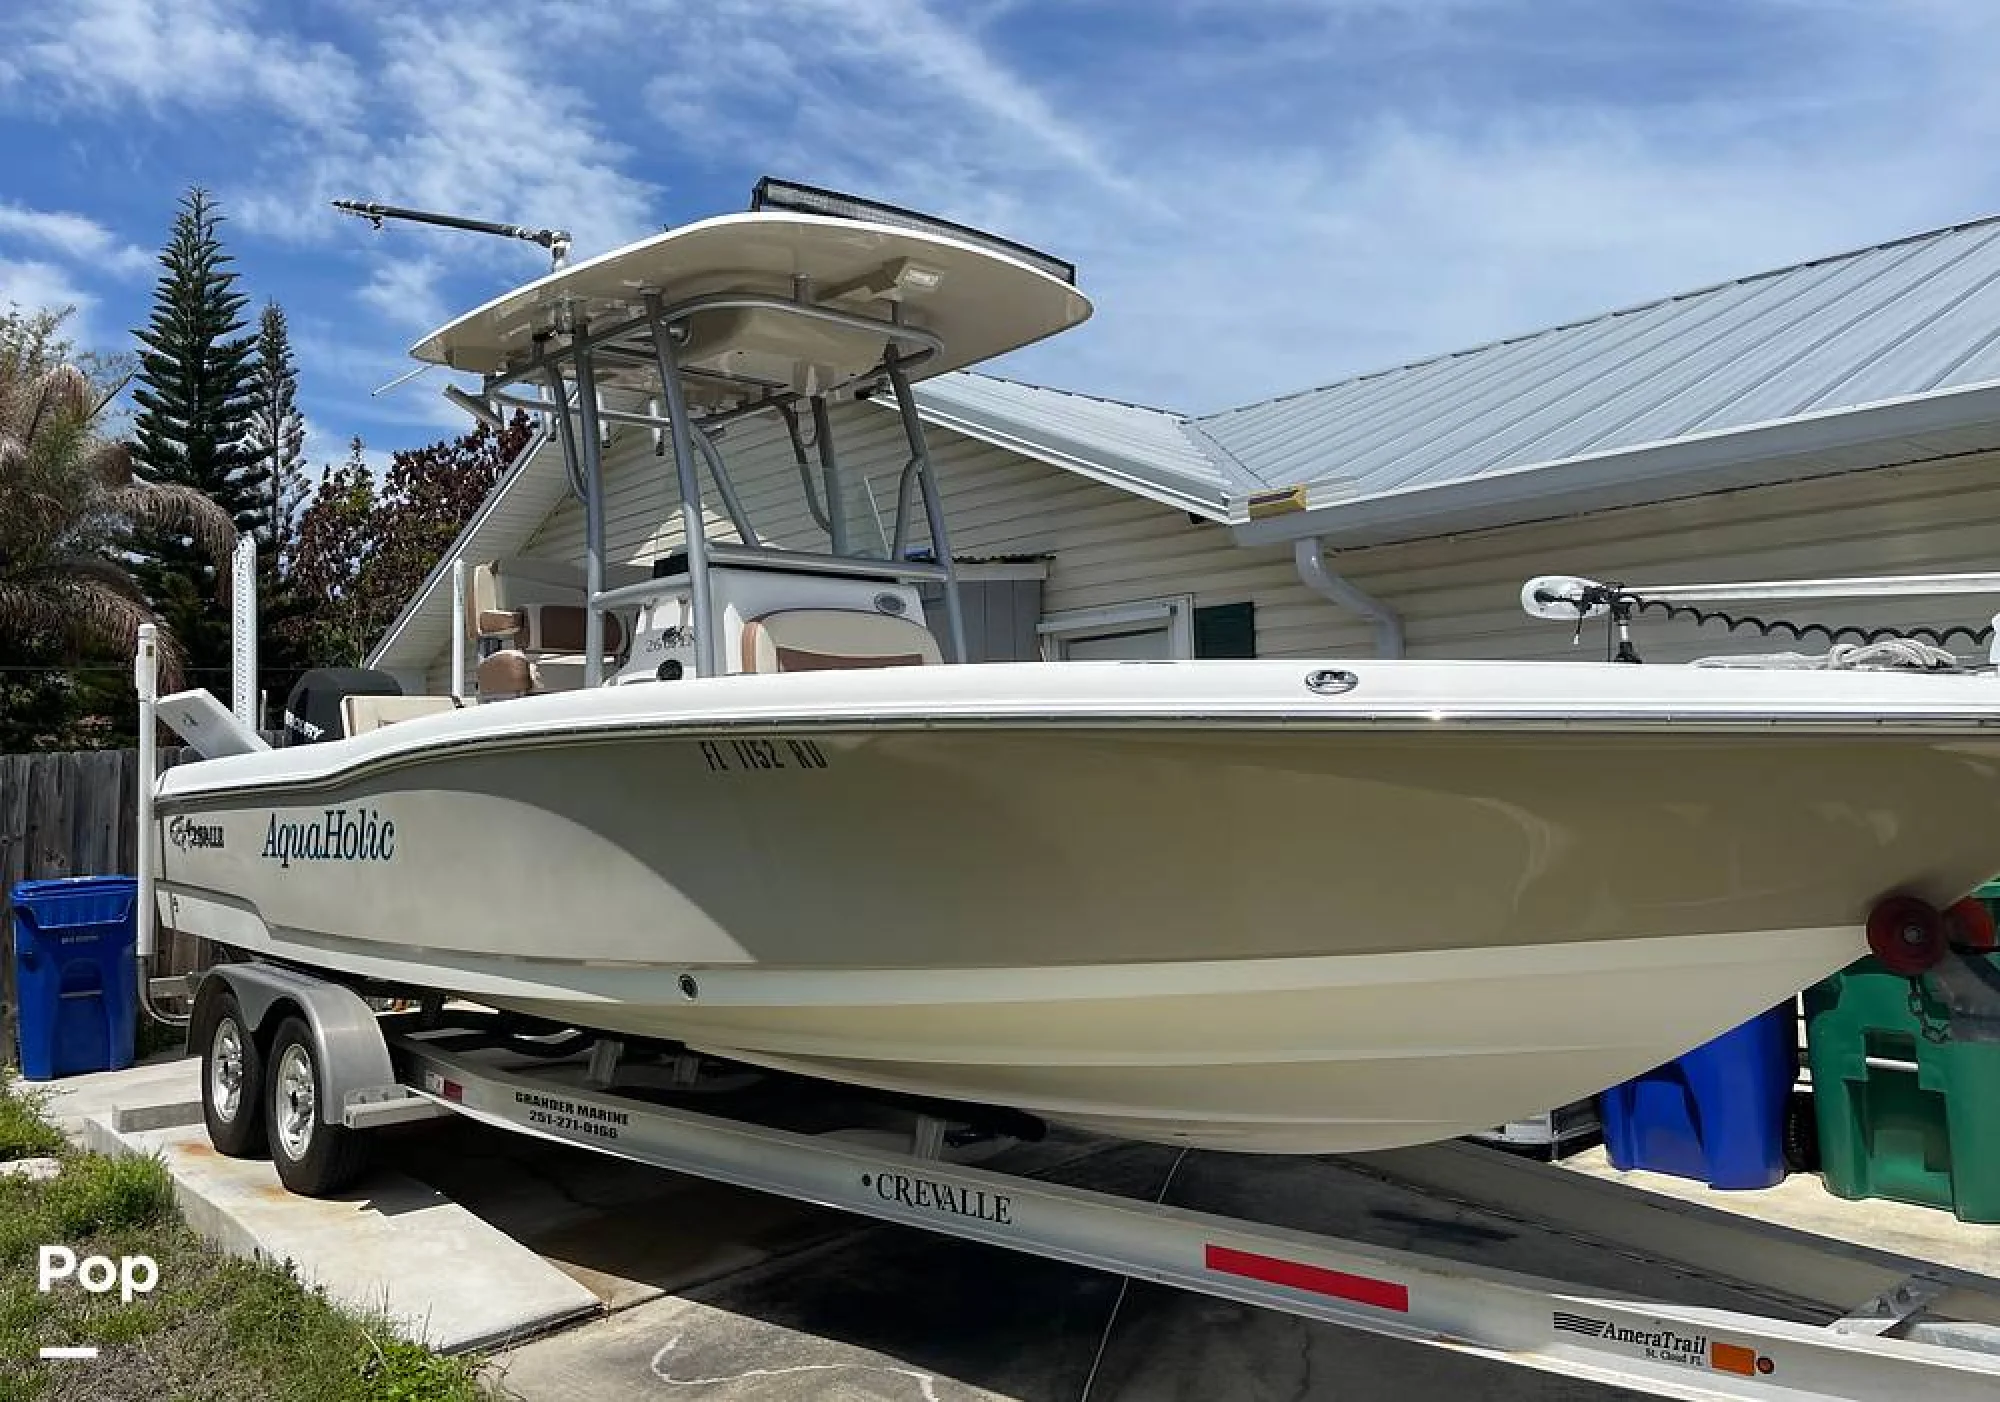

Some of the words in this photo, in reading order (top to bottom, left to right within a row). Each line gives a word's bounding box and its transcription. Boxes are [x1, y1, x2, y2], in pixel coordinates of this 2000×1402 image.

[261, 807, 395, 869] AquaHolic
[876, 1172, 1013, 1225] CREVALLE
[1602, 1321, 1707, 1355] AmeraTrail
